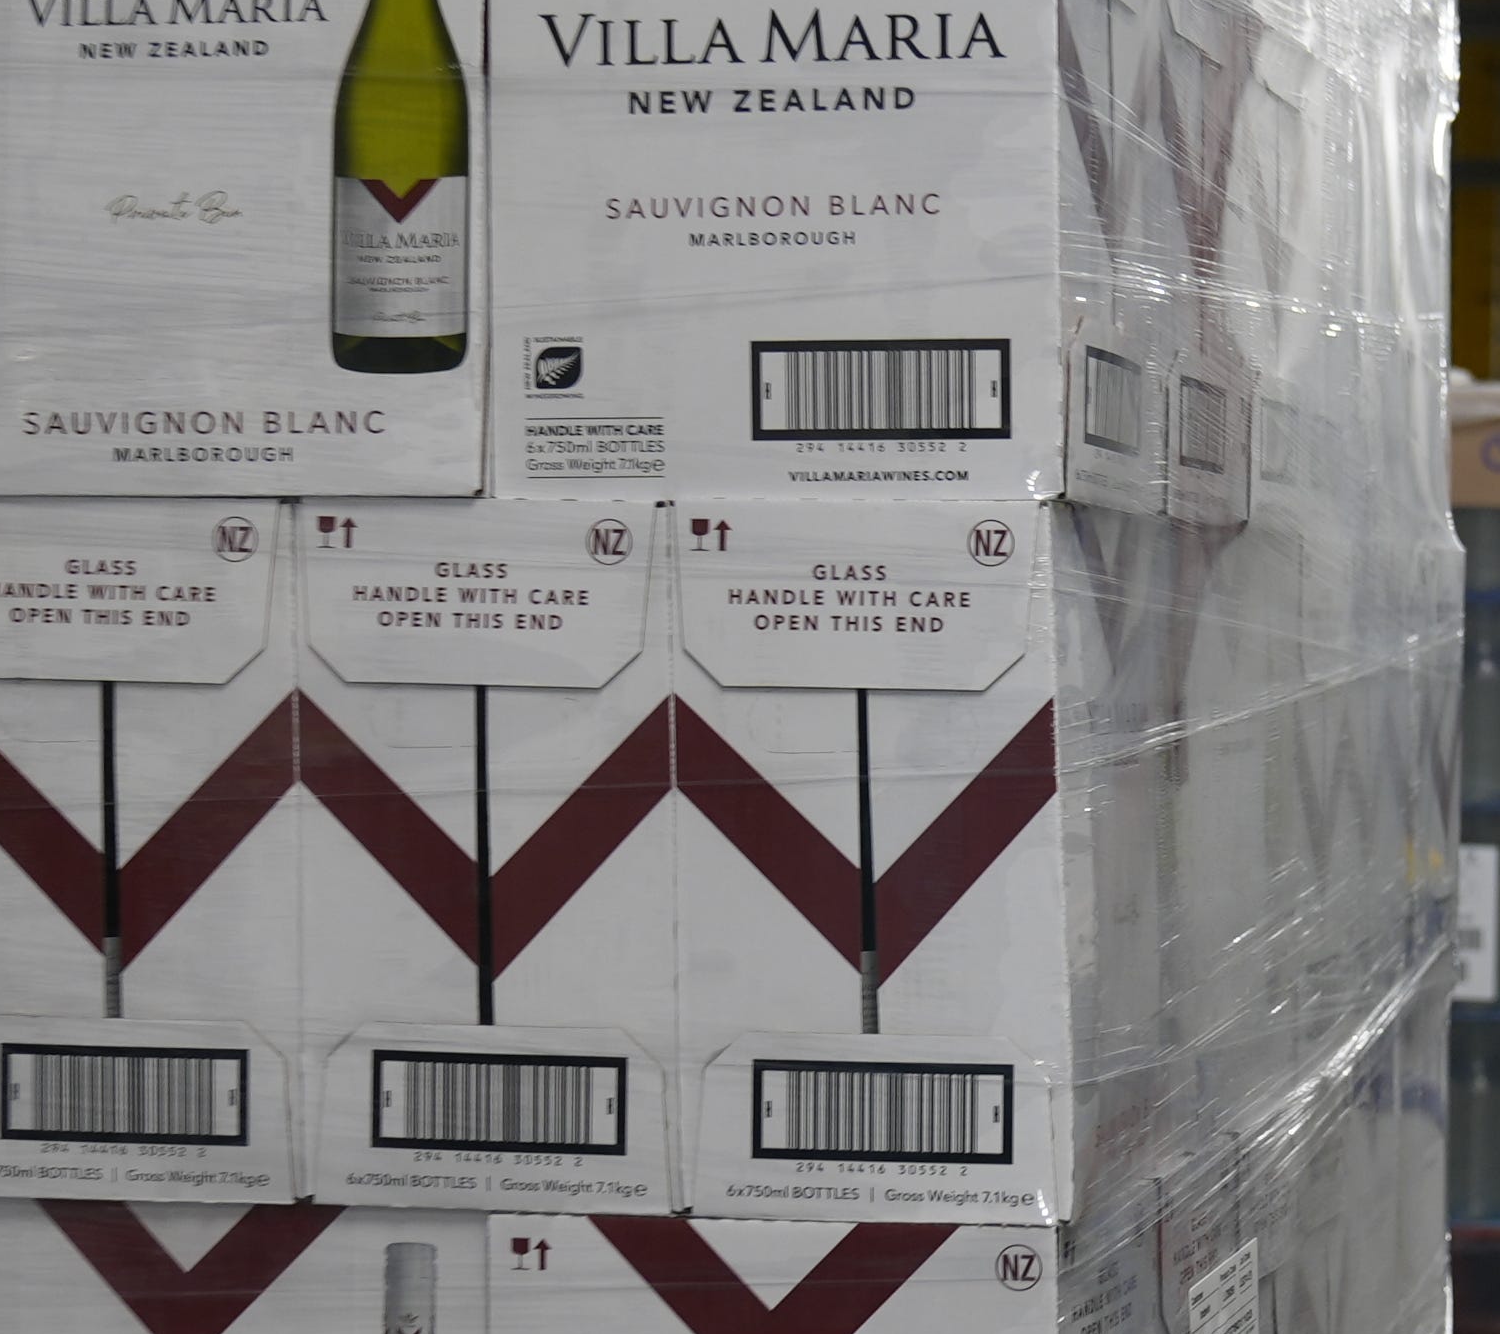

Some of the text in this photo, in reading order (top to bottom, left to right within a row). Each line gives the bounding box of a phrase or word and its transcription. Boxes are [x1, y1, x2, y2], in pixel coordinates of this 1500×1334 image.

[539, 9, 1006, 67] VILLA MARIA
[81, 41, 268, 58] NEW ZEALAND
[629, 87, 914, 114] NEW ZEALAND
[607, 193, 939, 219] SAUVIGNON BLANC
[690, 232, 855, 246] MARLBOROUGH
[23, 411, 384, 435] SAUVIGNON BLANC
[527, 425, 664, 436] HANDLE WITH CARE
[114, 447, 292, 462] MARLBOROUGH
[789, 471, 968, 481] VILLAMARIAWINES.COM
[590, 523, 628, 560] NZ
[972, 524, 1010, 561] NZ
[436, 562, 507, 578] GLASS
[813, 565, 886, 581] GLASS
[354, 587, 588, 605] HANDLE WITH CARE
[729, 589, 970, 607] HANDLE WITH CARE
[379, 611, 562, 630] OPEN THIS END
[755, 615, 943, 632] OPEN THIS END
[726, 1185, 789, 1198] 6x750ml
[792, 1187, 859, 1200] BOTTLES
[885, 1189, 924, 1202] Gross
[930, 1190, 978, 1206] Weight
[1000, 1249, 1039, 1285] NZ
